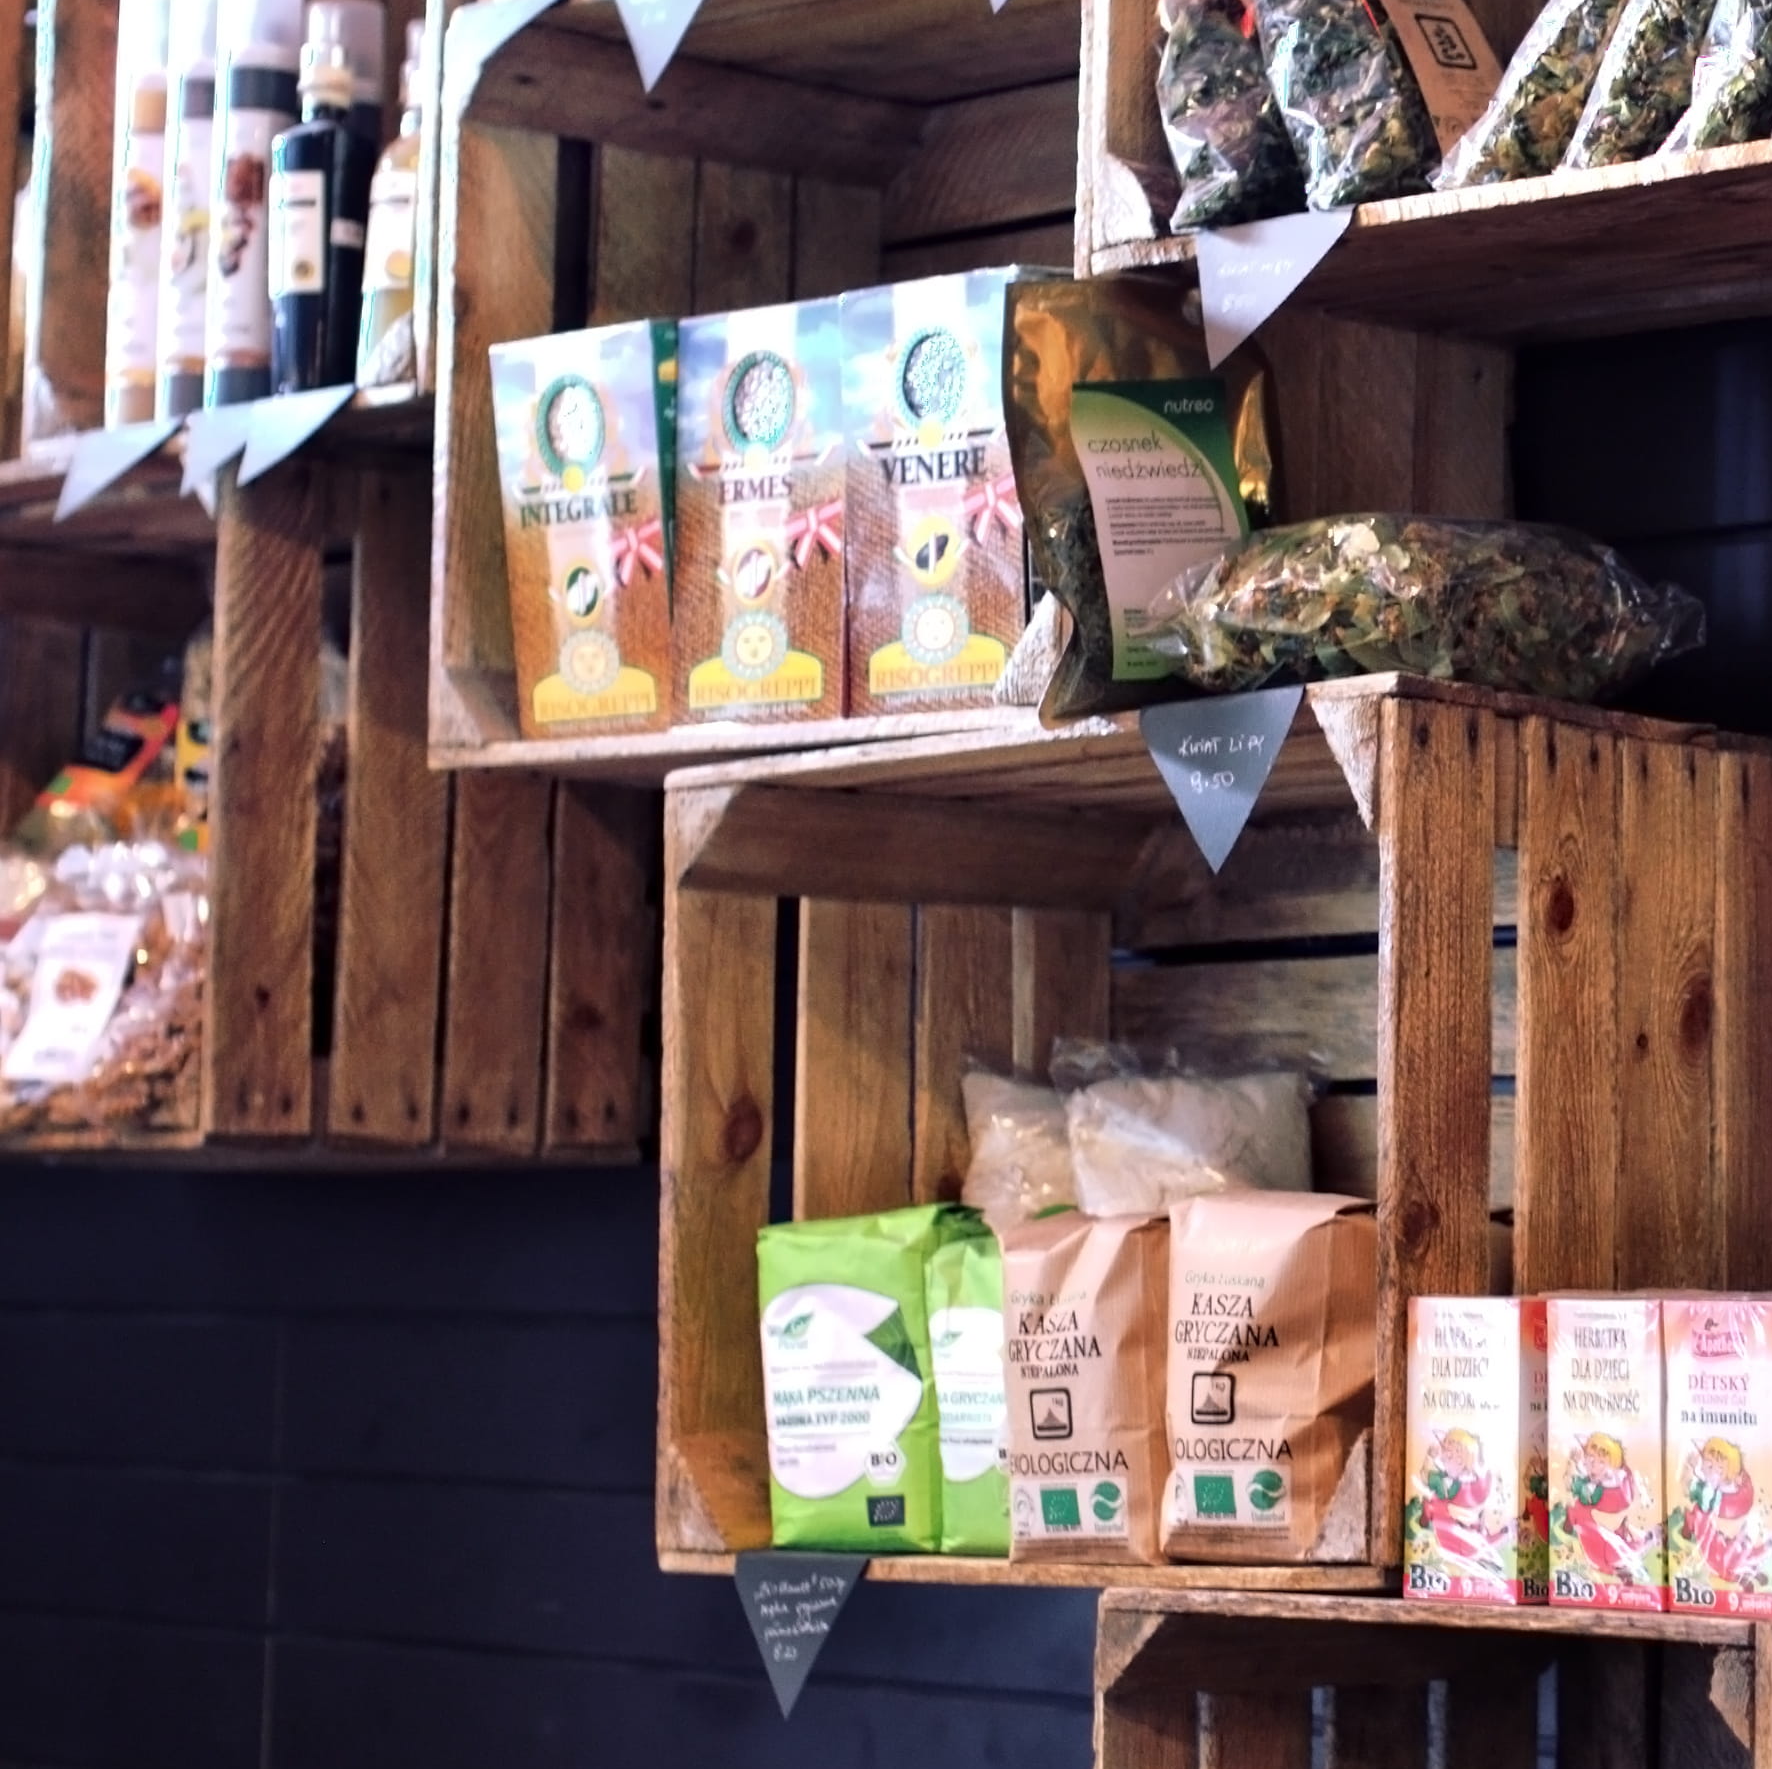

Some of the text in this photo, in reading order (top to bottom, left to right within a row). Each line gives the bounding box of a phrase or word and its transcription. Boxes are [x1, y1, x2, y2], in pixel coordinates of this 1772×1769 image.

[1087, 430, 1163, 454] czosnek
[881, 446, 987, 484] VENERE
[520, 489, 637, 529] INTEGRALE
[1191, 1292, 1254, 1319] KASZA
[1019, 1310, 1078, 1335] KASZA
[1174, 1320, 1280, 1347] GRYCZANA
[1008, 1335, 1102, 1362] GRYCZANA
[1186, 1347, 1250, 1362] NIEPALONA
[1432, 1357, 1451, 1378] DLA
[1571, 1357, 1630, 1381] DLA DZIECI
[807, 1385, 880, 1403] PSZENNA
[1563, 1390, 1579, 1410] NA
[1700, 1408, 1758, 1426] imunitu
[1175, 1437, 1293, 1461] OLOGICZNA
[1676, 1577, 1714, 1605] Bio
